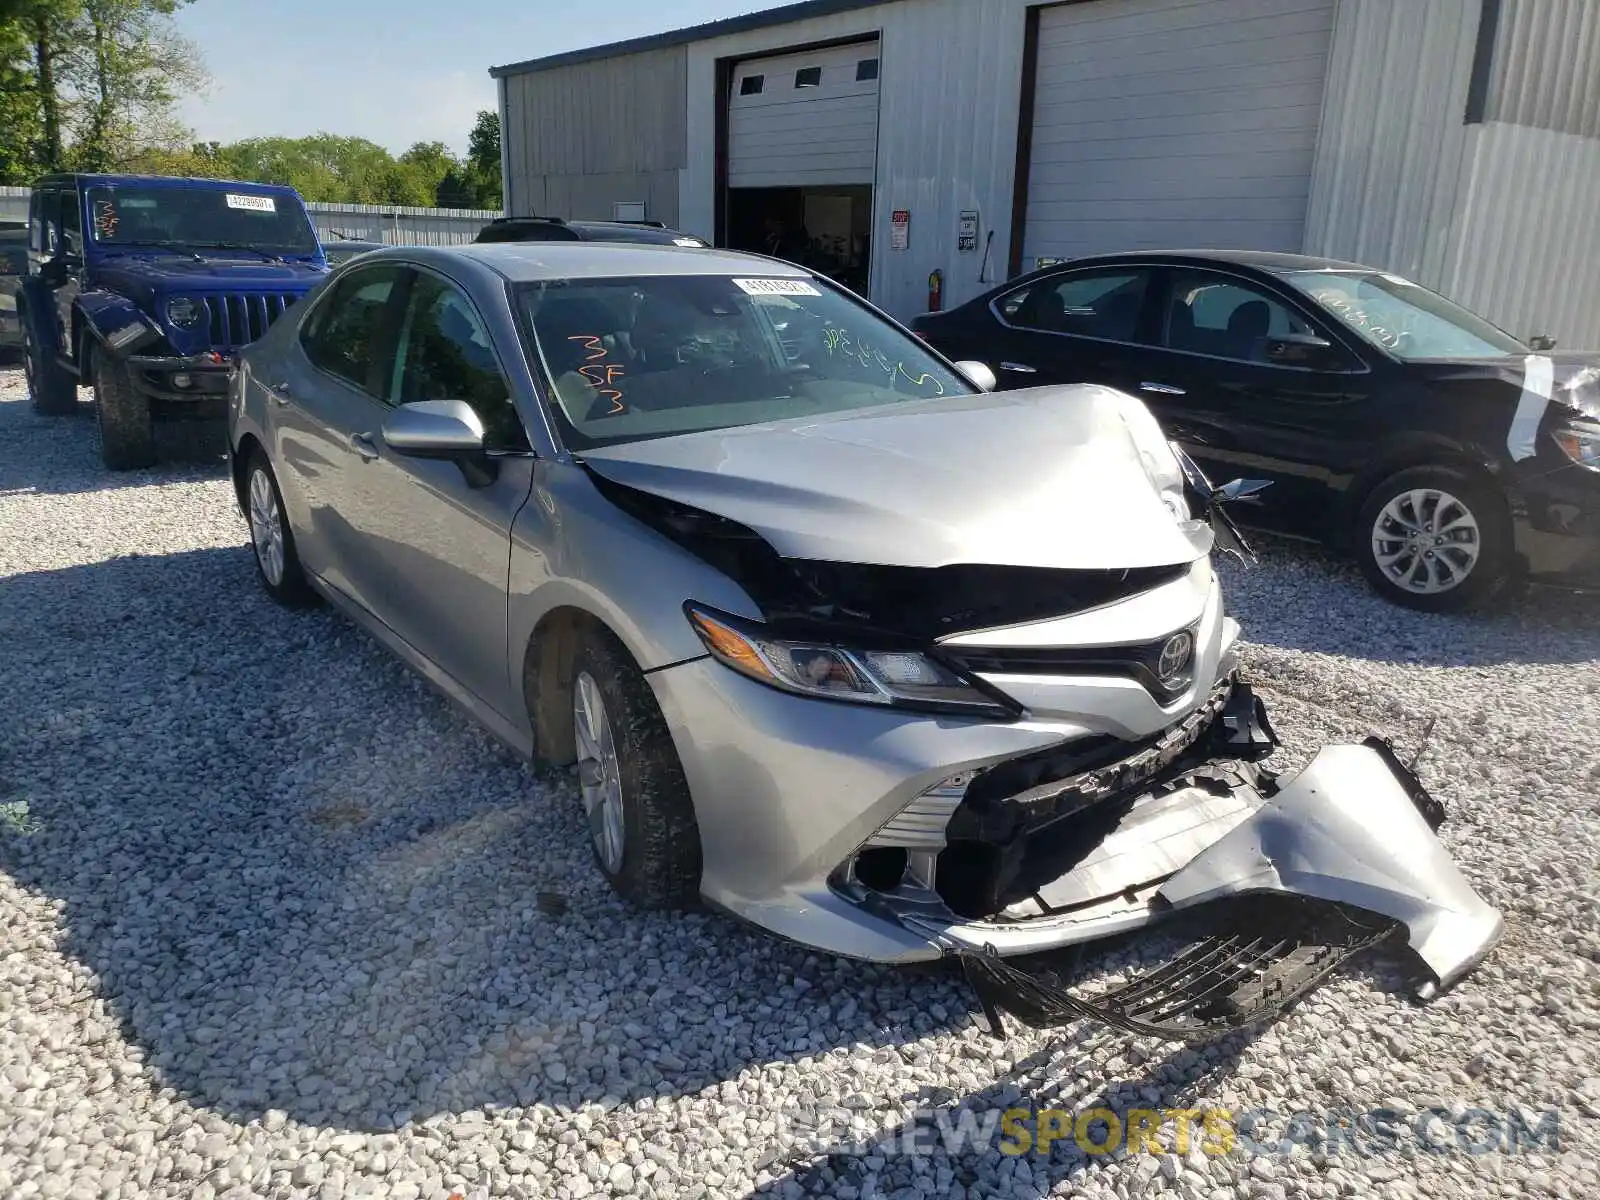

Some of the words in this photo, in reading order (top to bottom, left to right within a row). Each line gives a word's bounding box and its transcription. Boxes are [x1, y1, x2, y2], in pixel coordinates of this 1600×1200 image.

[568, 335, 608, 360] 3
[578, 364, 625, 388] SF
[599, 389, 624, 414] 3
